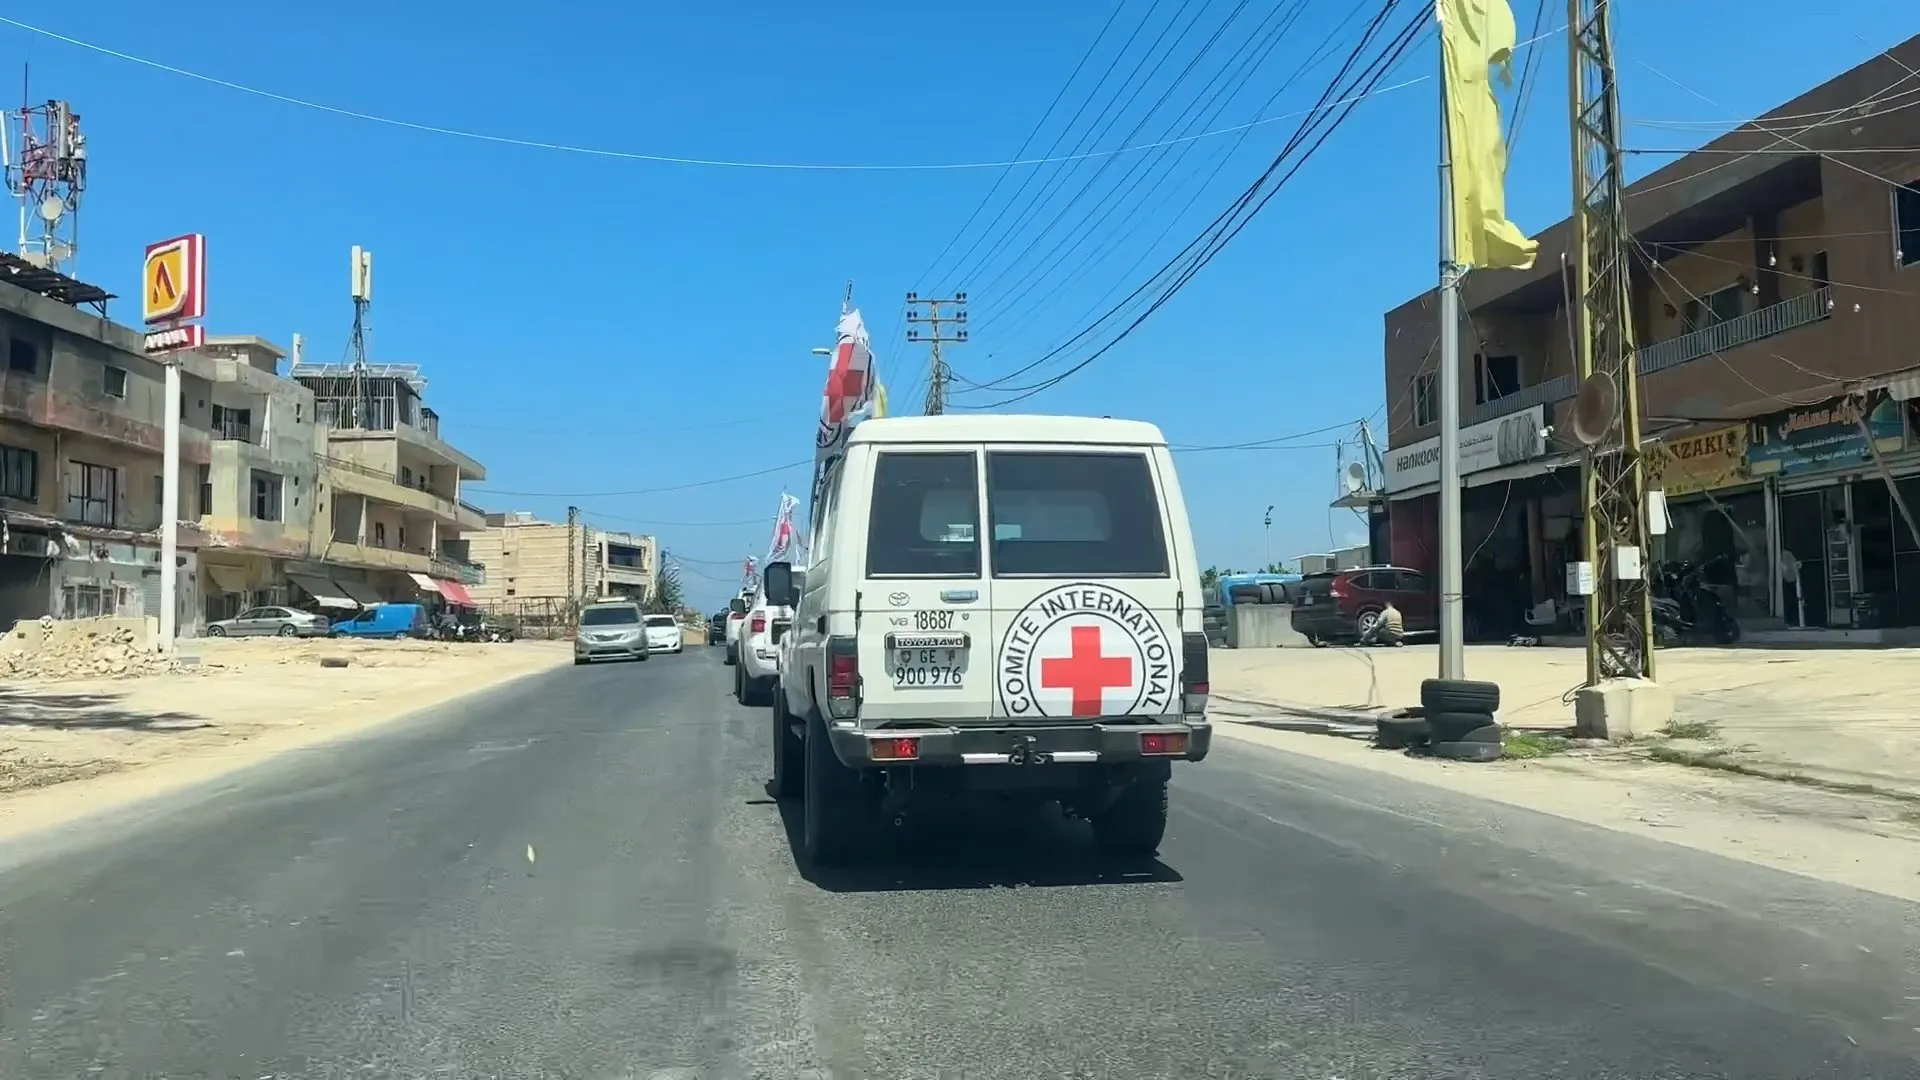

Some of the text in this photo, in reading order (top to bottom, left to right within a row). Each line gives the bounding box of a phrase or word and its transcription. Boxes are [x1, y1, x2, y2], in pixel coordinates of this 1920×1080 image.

[914, 610, 954, 630] 18687
[898, 638, 963, 647] TOYOTA 4WD
[1005, 590, 1168, 714] COMITE INTERNATIONAL
[920, 649, 936, 664] GE
[896, 666, 962, 685] 900 976
